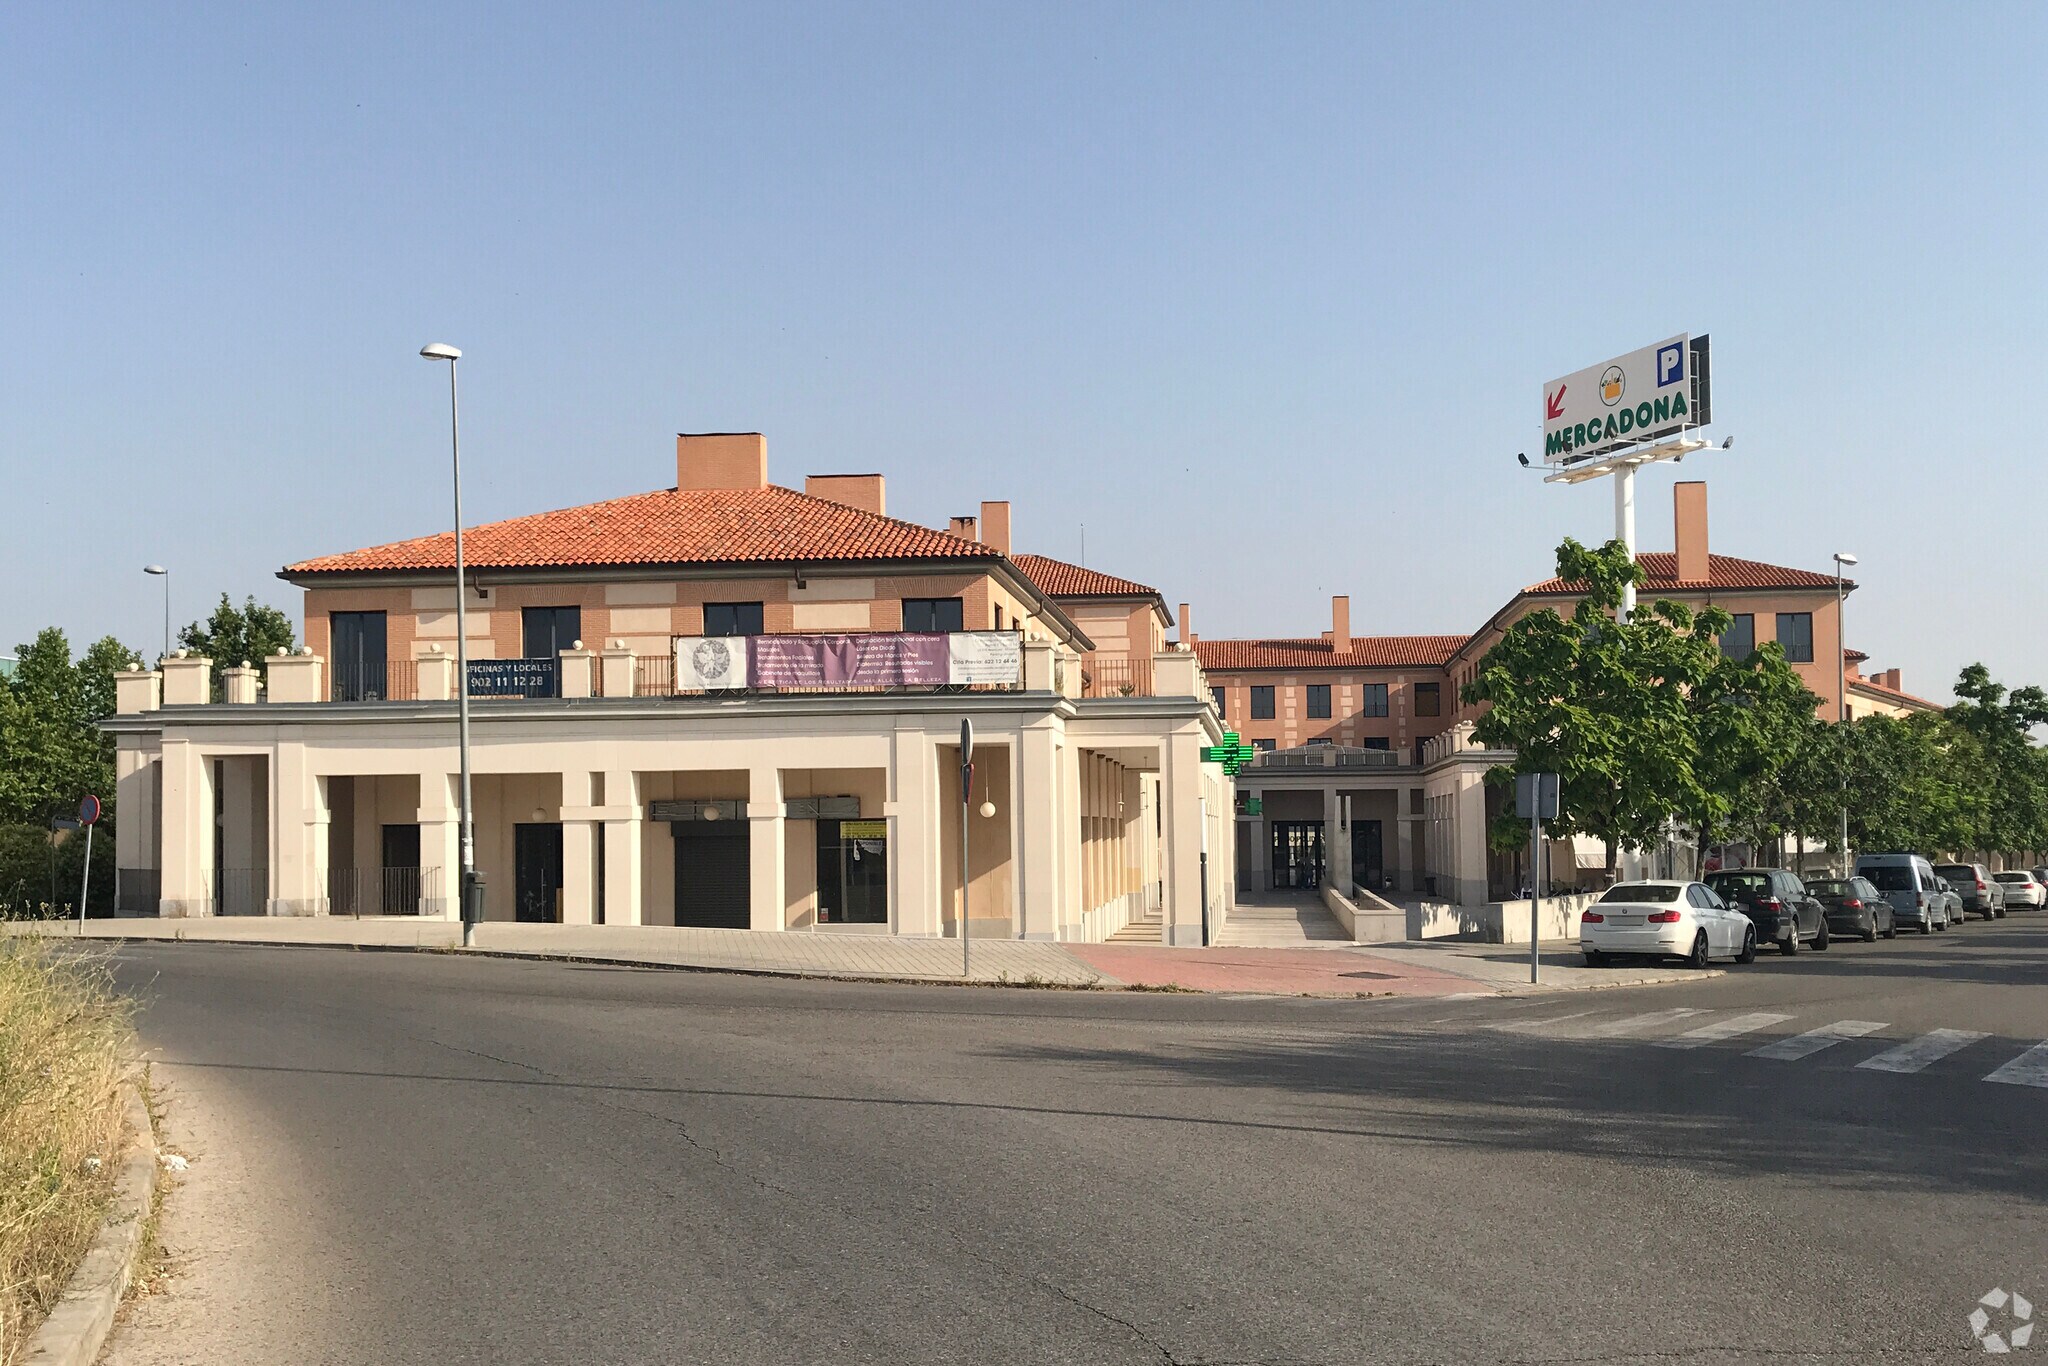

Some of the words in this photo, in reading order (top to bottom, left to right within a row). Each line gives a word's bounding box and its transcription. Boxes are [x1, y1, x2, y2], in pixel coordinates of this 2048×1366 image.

[1660, 348, 1679, 383] P
[1545, 391, 1688, 457] MERCADONA
[513, 664, 552, 672] LOCALES
[471, 677, 491, 687] 902
[496, 677, 508, 686] 11
[513, 676, 526, 686] 12
[529, 676, 543, 686] 28
